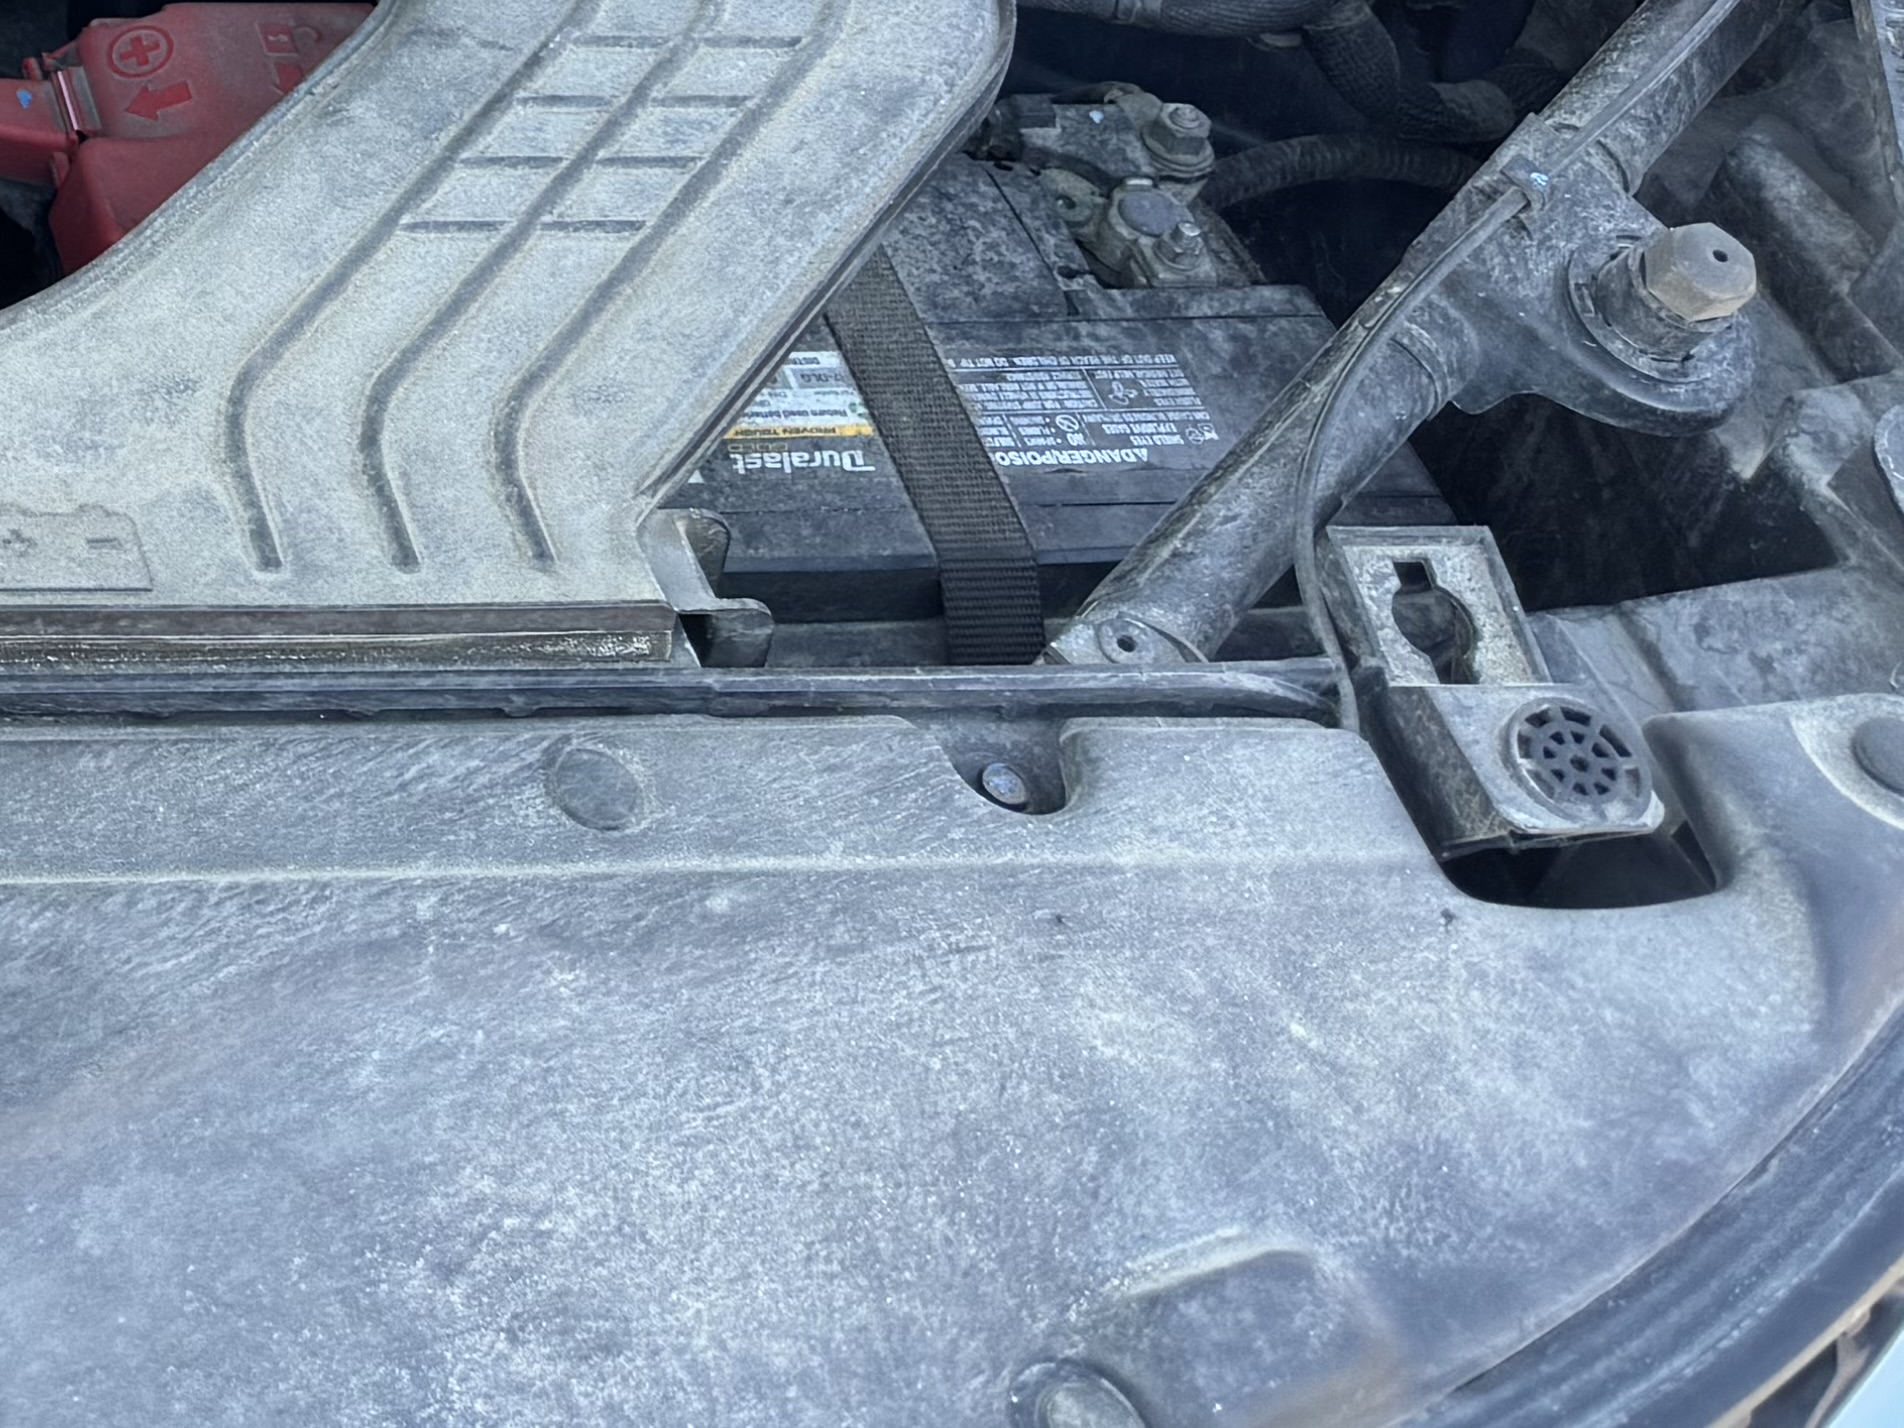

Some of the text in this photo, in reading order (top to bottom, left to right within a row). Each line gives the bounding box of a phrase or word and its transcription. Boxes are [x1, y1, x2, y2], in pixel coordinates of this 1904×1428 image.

[783, 409, 809, 418] used
[811, 409, 847, 417] Return
[733, 427, 836, 436] PROVEN TOUGH
[727, 442, 787, 452] GOLD
[729, 449, 876, 474] Duralast
